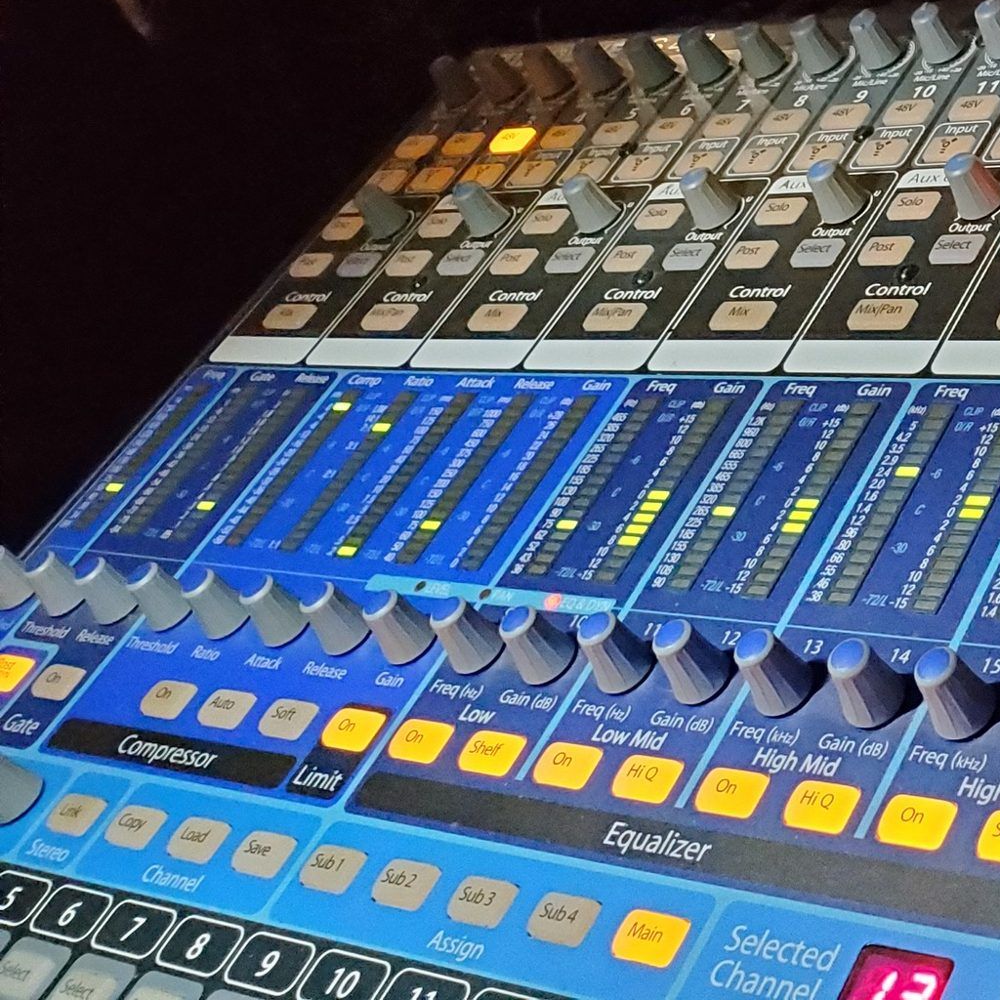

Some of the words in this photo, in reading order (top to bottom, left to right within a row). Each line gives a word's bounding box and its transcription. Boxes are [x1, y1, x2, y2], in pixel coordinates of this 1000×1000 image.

[949, 222, 992, 236] Output
[865, 282, 932, 297] Control
[456, 376, 496, 389] Attack
[126, 635, 180, 655] Threshold
[190, 645, 220, 661] Ratio
[890, 648, 913, 665] 14
[244, 653, 283, 671] Attack
[302, 660, 348, 681] Release
[374, 671, 404, 688] Gain
[209, 696, 236, 711] Auto
[271, 705, 297, 722] Soft
[458, 704, 496, 725] Low
[3, 712, 42, 738] Gate
[469, 738, 503, 757] Shelf
[592, 724, 629, 746] Low
[629, 729, 668, 751] Mid
[729, 720, 766, 743] Freq
[767, 726, 800, 746] (kHz)
[819, 733, 855, 752] Gain
[857, 739, 889, 760] (dB)
[117, 733, 219, 770] Compressor
[752, 747, 797, 774] High
[799, 756, 842, 777] Mid
[909, 745, 945, 769] Freq
[951, 751, 988, 773] (kHz)
[292, 763, 344, 793] Limit
[118, 813, 148, 832] Copy
[900, 806, 924, 825] On
[180, 826, 211, 844] Load
[602, 820, 713, 863] Equalizer
[25, 838, 71, 863] Stereo
[244, 839, 272, 856] Save
[141, 863, 205, 893] Channel
[57, 901, 84, 927] 6
[119, 917, 147, 942] 7
[627, 921, 664, 944] Main
[185, 933, 211, 960] 8
[426, 929, 486, 962] Assign
[723, 924, 842, 973] Selected
[255, 950, 282, 978] 9
[324, 967, 362, 1000] 10
[708, 959, 822, 1000] Channel
